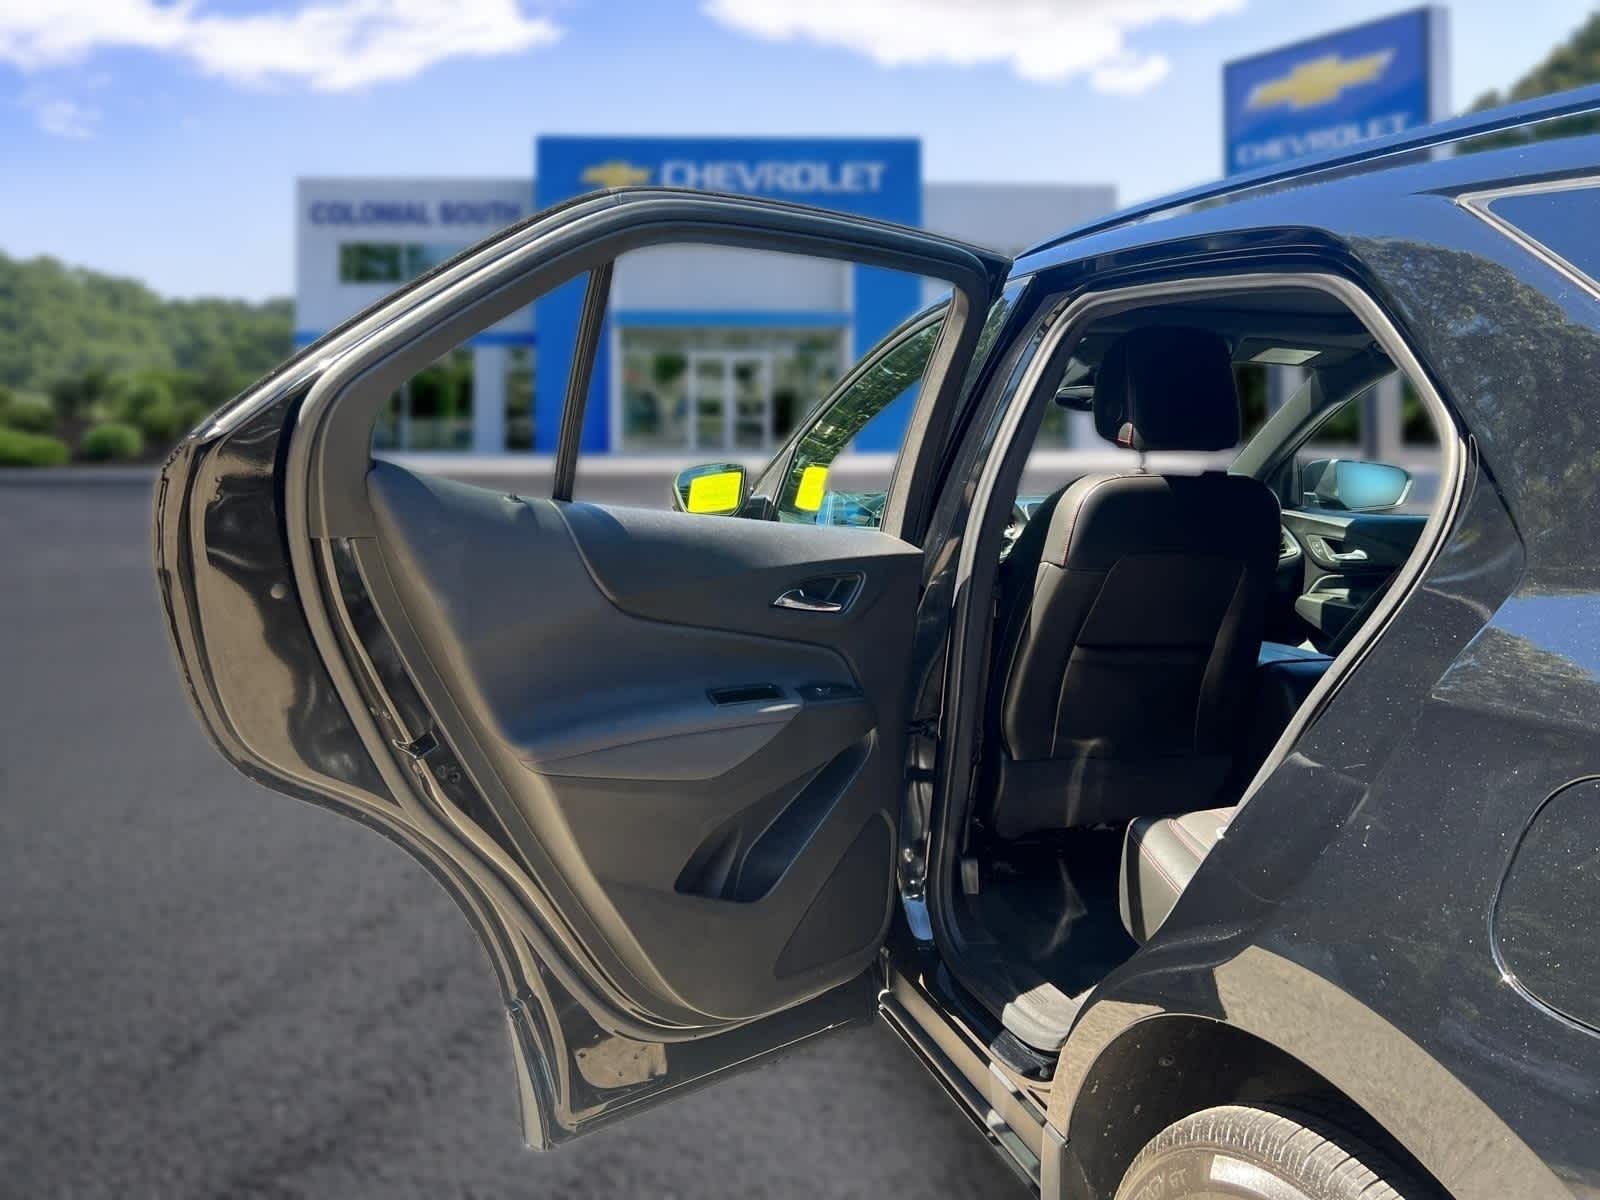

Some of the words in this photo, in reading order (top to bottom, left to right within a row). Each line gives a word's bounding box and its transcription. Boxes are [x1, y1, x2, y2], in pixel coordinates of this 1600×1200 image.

[1236, 113, 1411, 166] CHEVROLET
[660, 160, 885, 193] CHEVROLET
[309, 200, 431, 226] COLONIAL
[439, 200, 522, 226] SOUTH
